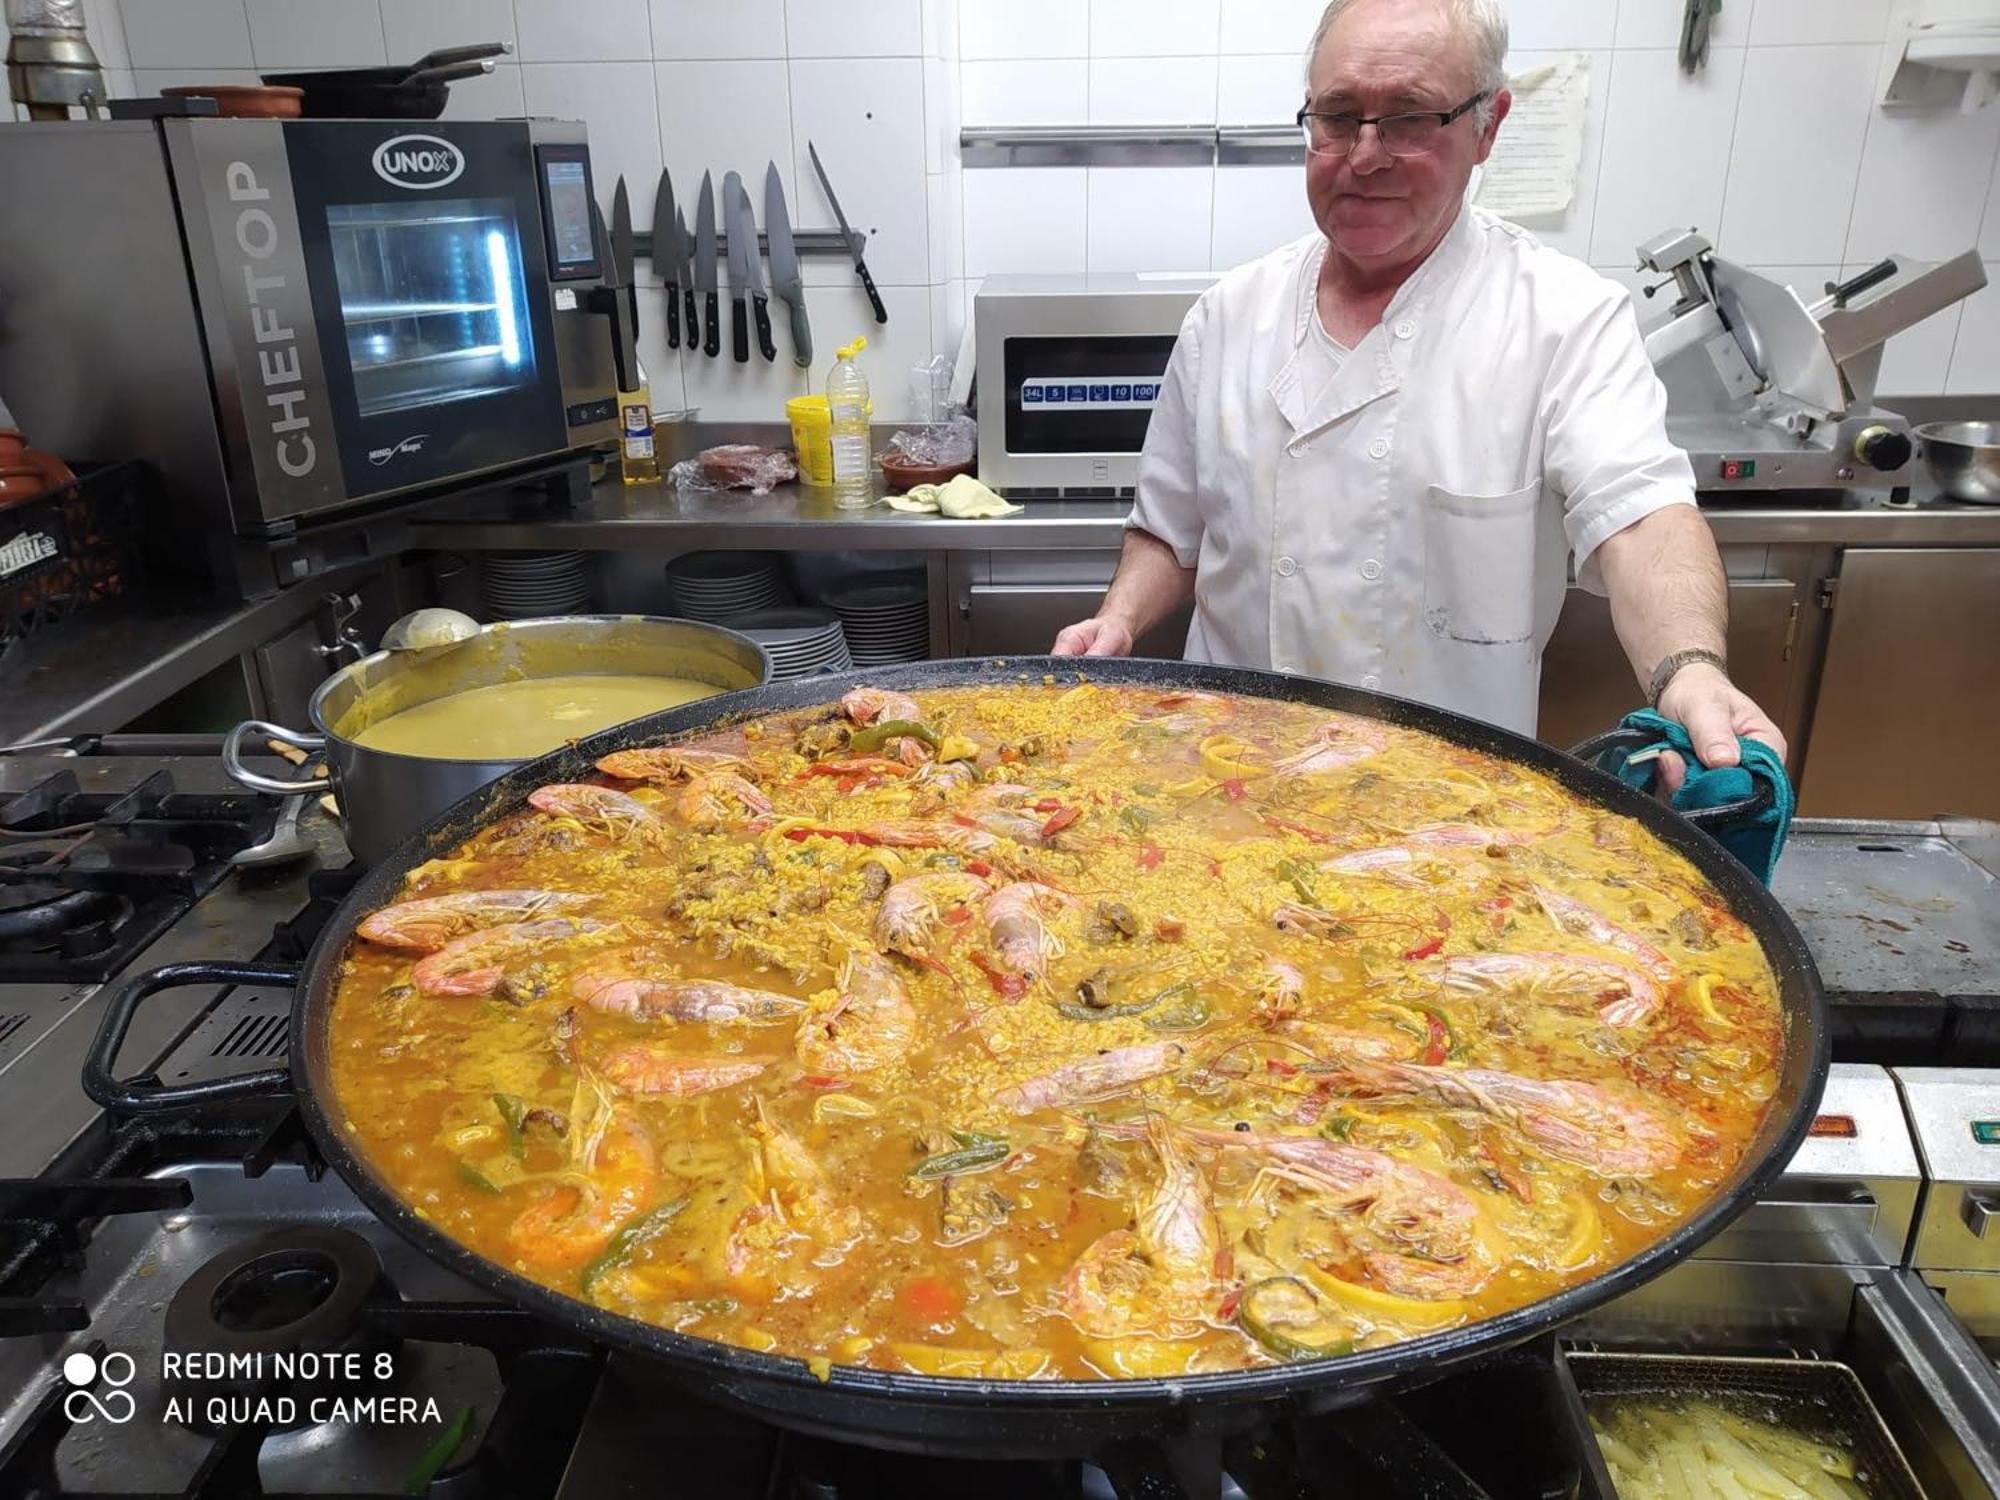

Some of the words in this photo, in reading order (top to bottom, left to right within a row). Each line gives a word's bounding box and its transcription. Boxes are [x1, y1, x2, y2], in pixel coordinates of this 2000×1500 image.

[383, 150, 450, 174] UNOX
[226, 161, 316, 477] CHEFTOP
[1116, 387, 1127, 396] 10
[1135, 387, 1153, 396] 100
